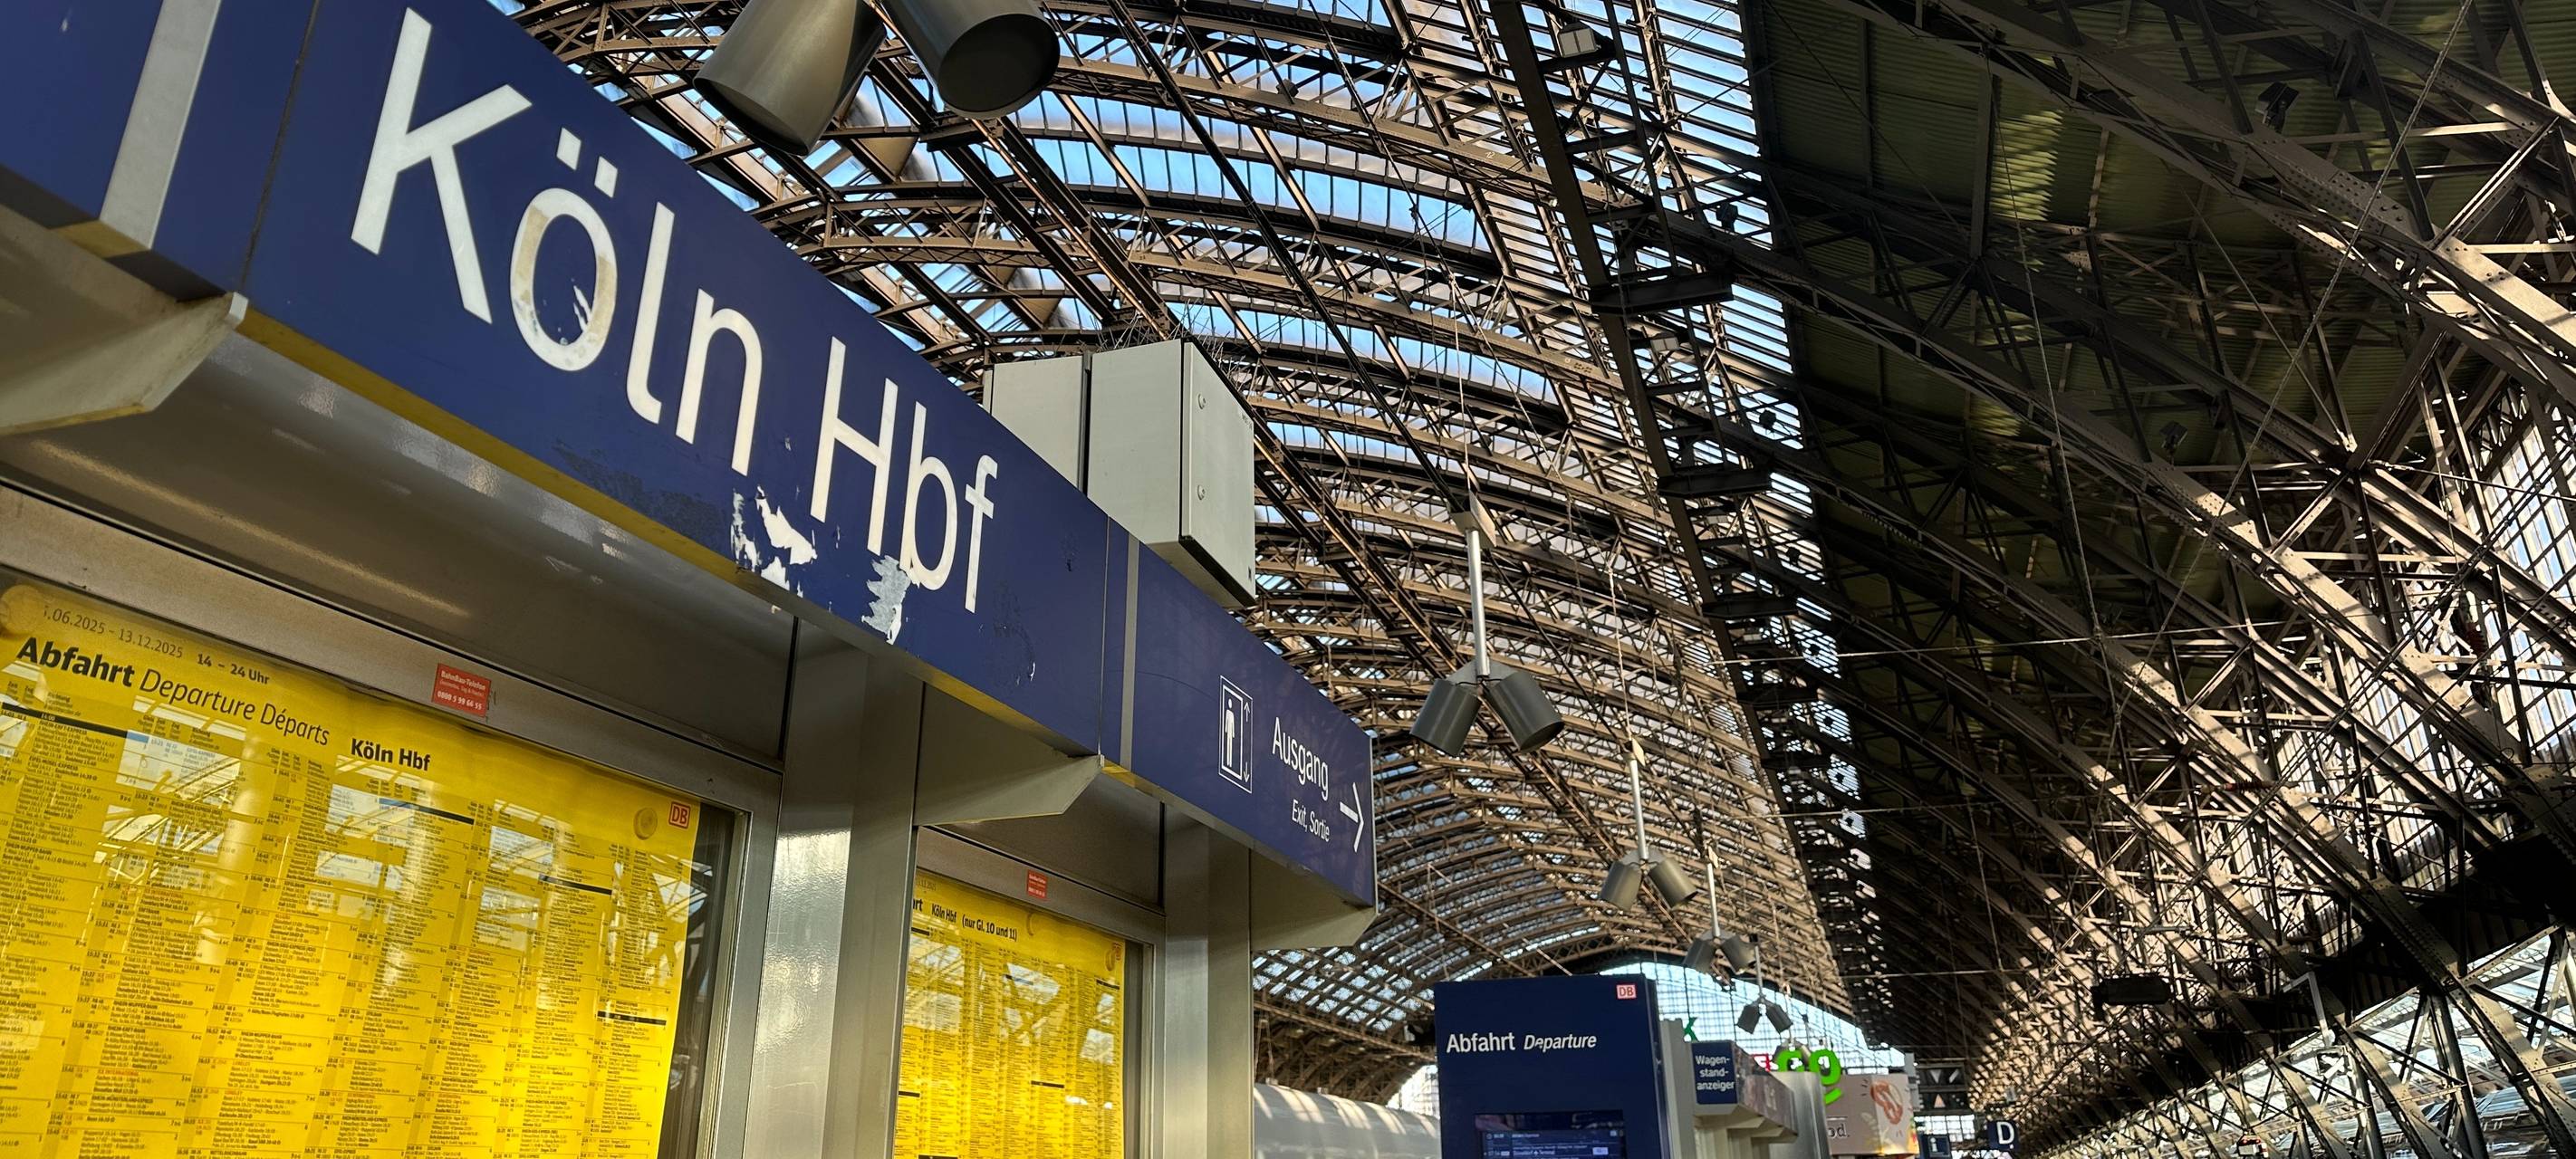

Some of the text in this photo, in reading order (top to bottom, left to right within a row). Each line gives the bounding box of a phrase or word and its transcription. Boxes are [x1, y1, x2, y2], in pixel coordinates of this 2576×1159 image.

[351, 6, 998, 614] Köln Hbf
[119, 627, 183, 658] 13.12.2025
[197, 653, 212, 667] 14
[230, 664, 245, 679] 24
[248, 666, 271, 685] Uhr
[16, 637, 330, 746] Abfahrt Departure Départs
[351, 738, 430, 771] Köln Hbf
[1272, 716, 1329, 801] Ausgang
[670, 803, 689, 827] DB
[1292, 799, 1330, 842] Exit, Sortie
[1618, 986, 1635, 998] DB
[1447, 1031, 1597, 1054] Abfahrt Departure
[1695, 1055, 1731, 1067] Wagen-
[1699, 1068, 1728, 1078] stand-
[1697, 1079, 1735, 1092] anzeiger
[1996, 1121, 2015, 1145] D
